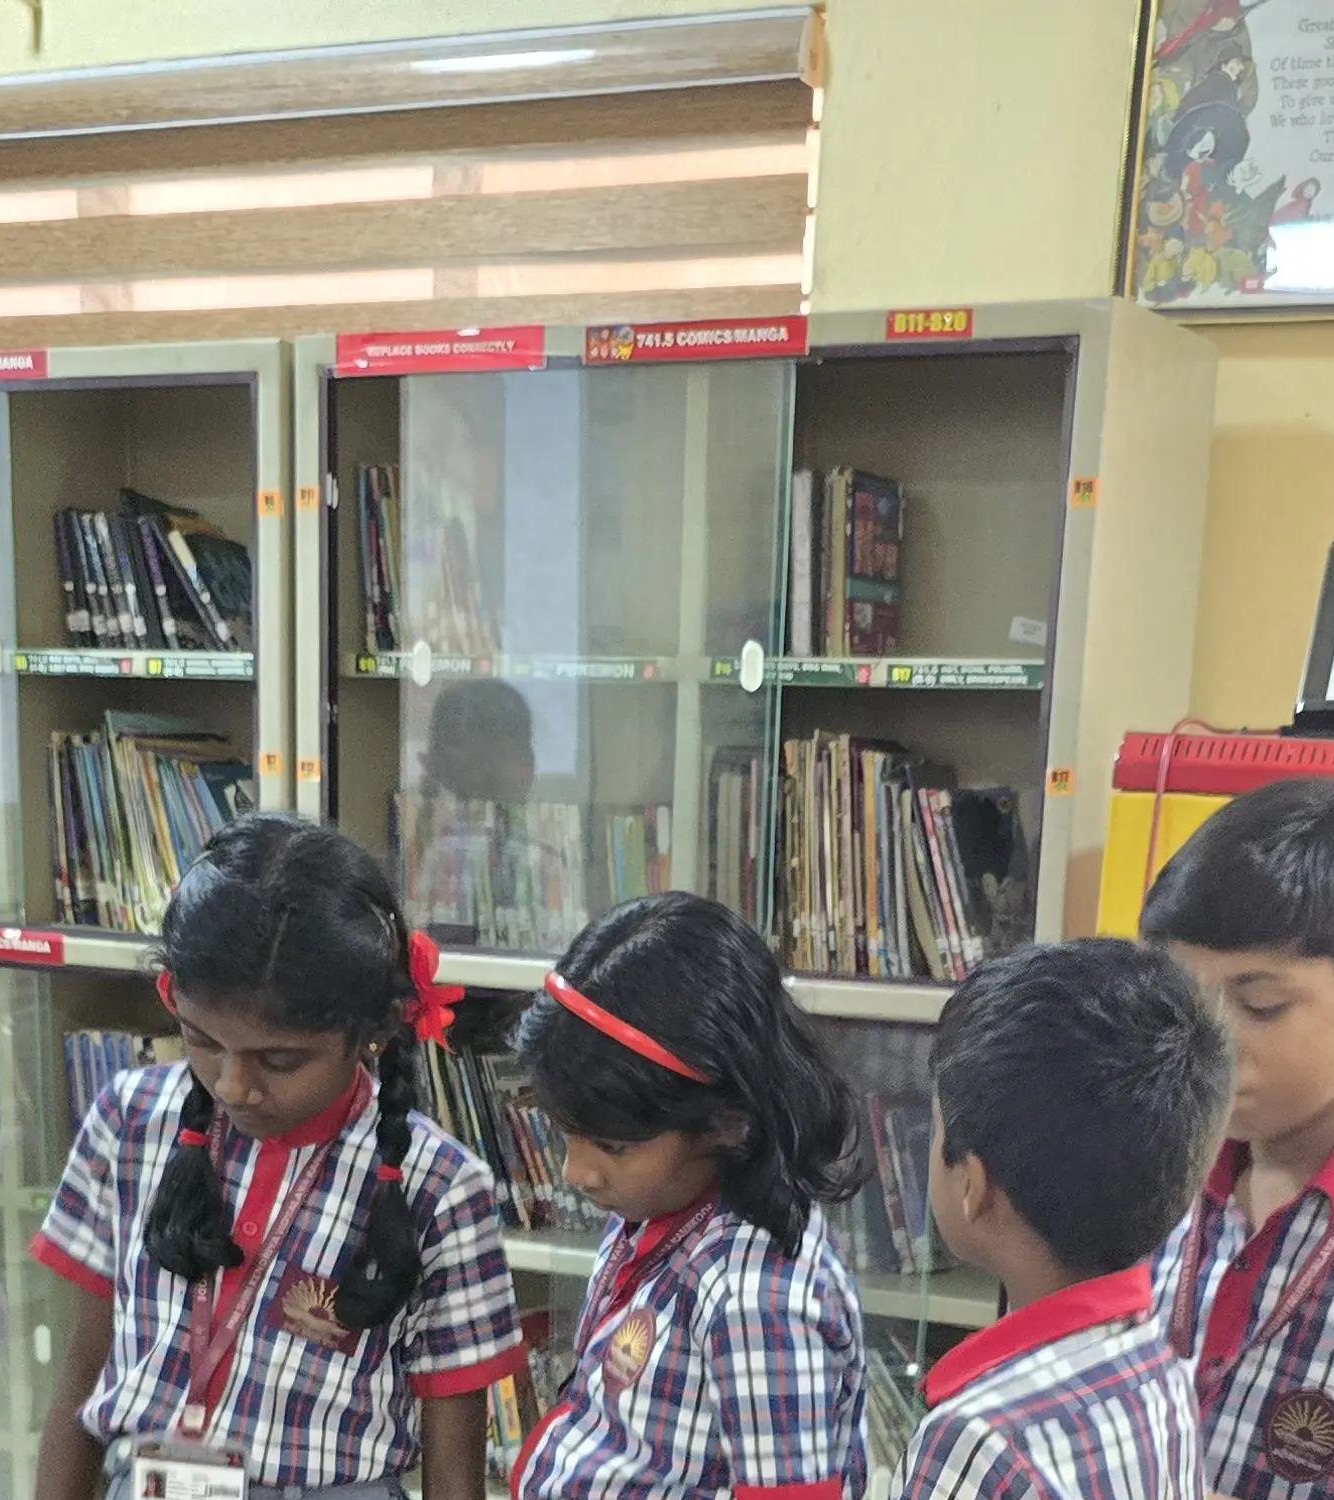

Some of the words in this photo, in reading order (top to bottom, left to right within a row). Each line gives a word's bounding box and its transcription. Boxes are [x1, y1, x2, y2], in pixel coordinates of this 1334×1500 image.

[1269, 56, 1288, 72] Of
[1290, 54, 1321, 70] time
[1272, 75, 1308, 90] These
[1280, 95, 1295, 109] To
[1298, 93, 1324, 110] give
[1270, 113, 1286, 128] We
[1290, 111, 1315, 127] who
[894, 312, 967, 333] B11-B20
[637, 332, 674, 348] 741.5
[415, 343, 451, 355] BOOKS
